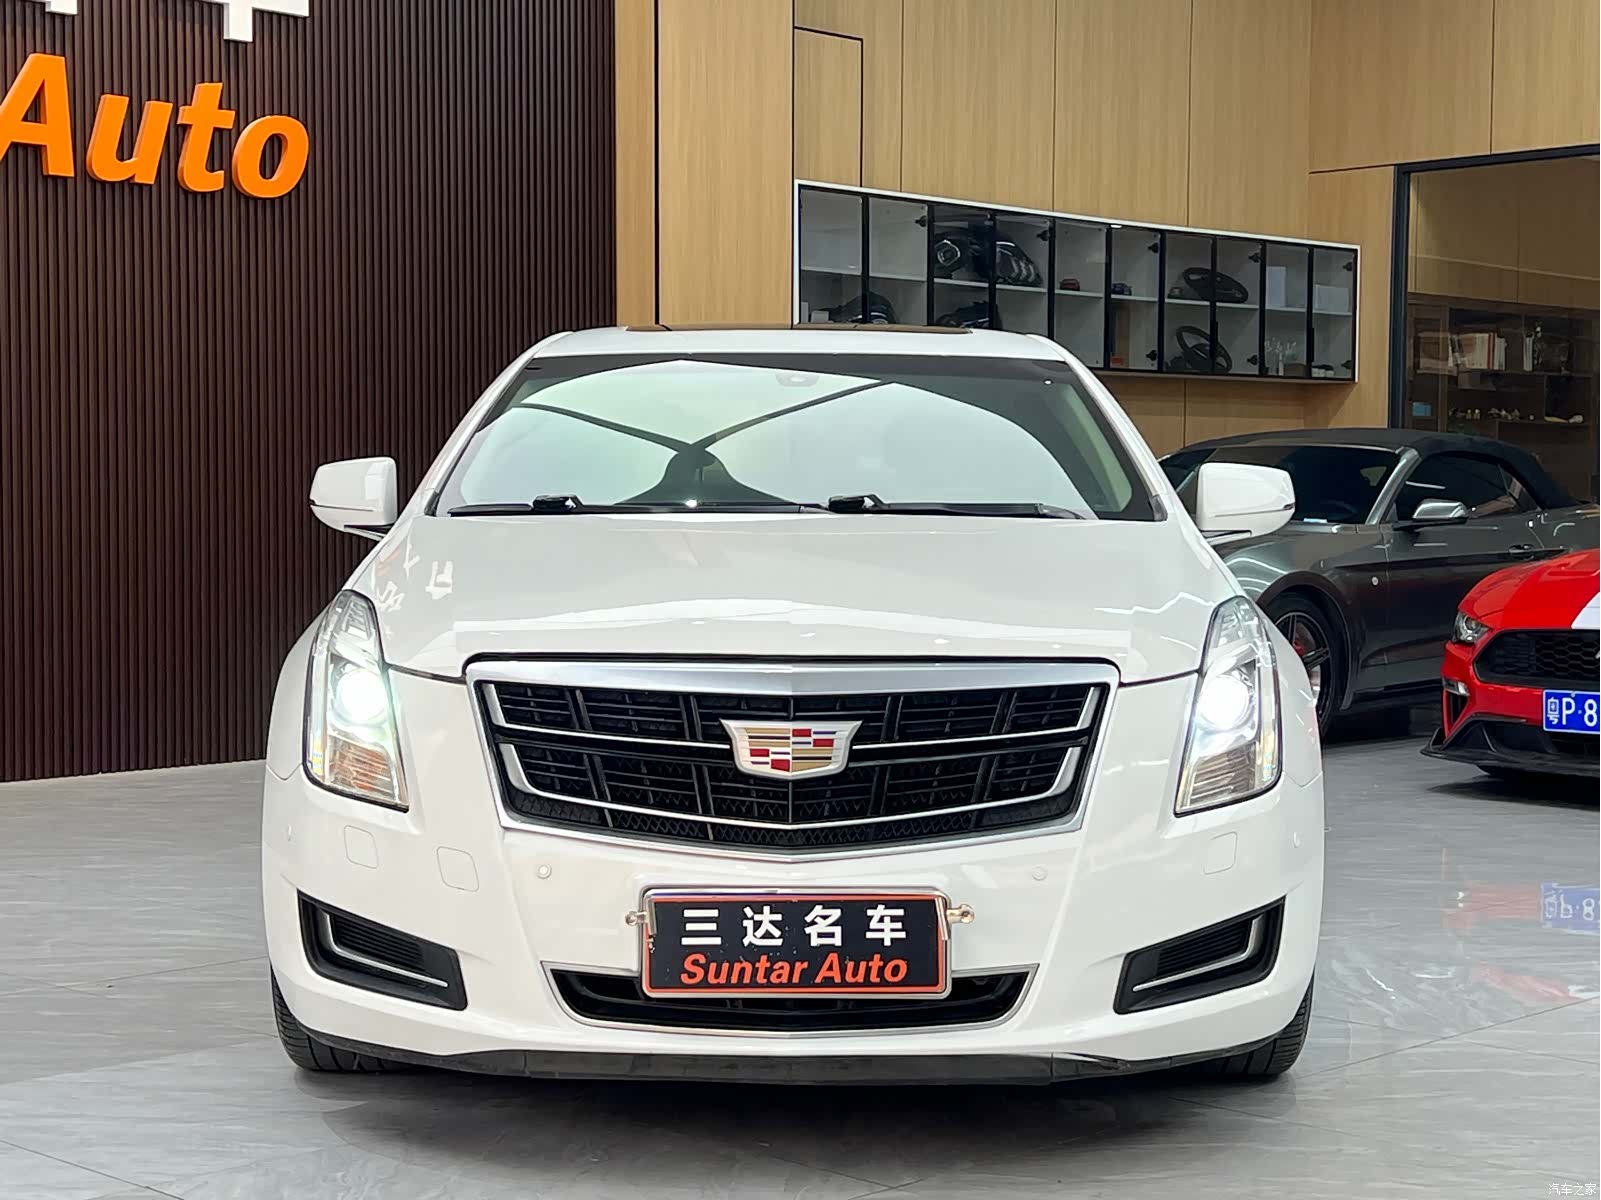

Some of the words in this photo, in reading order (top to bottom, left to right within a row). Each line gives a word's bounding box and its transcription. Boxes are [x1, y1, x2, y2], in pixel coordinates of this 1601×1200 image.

[0, 52, 309, 198] Auto
[681, 904, 907, 947] 三达名车
[680, 952, 808, 985] Suntar
[814, 952, 908, 984] Auto
